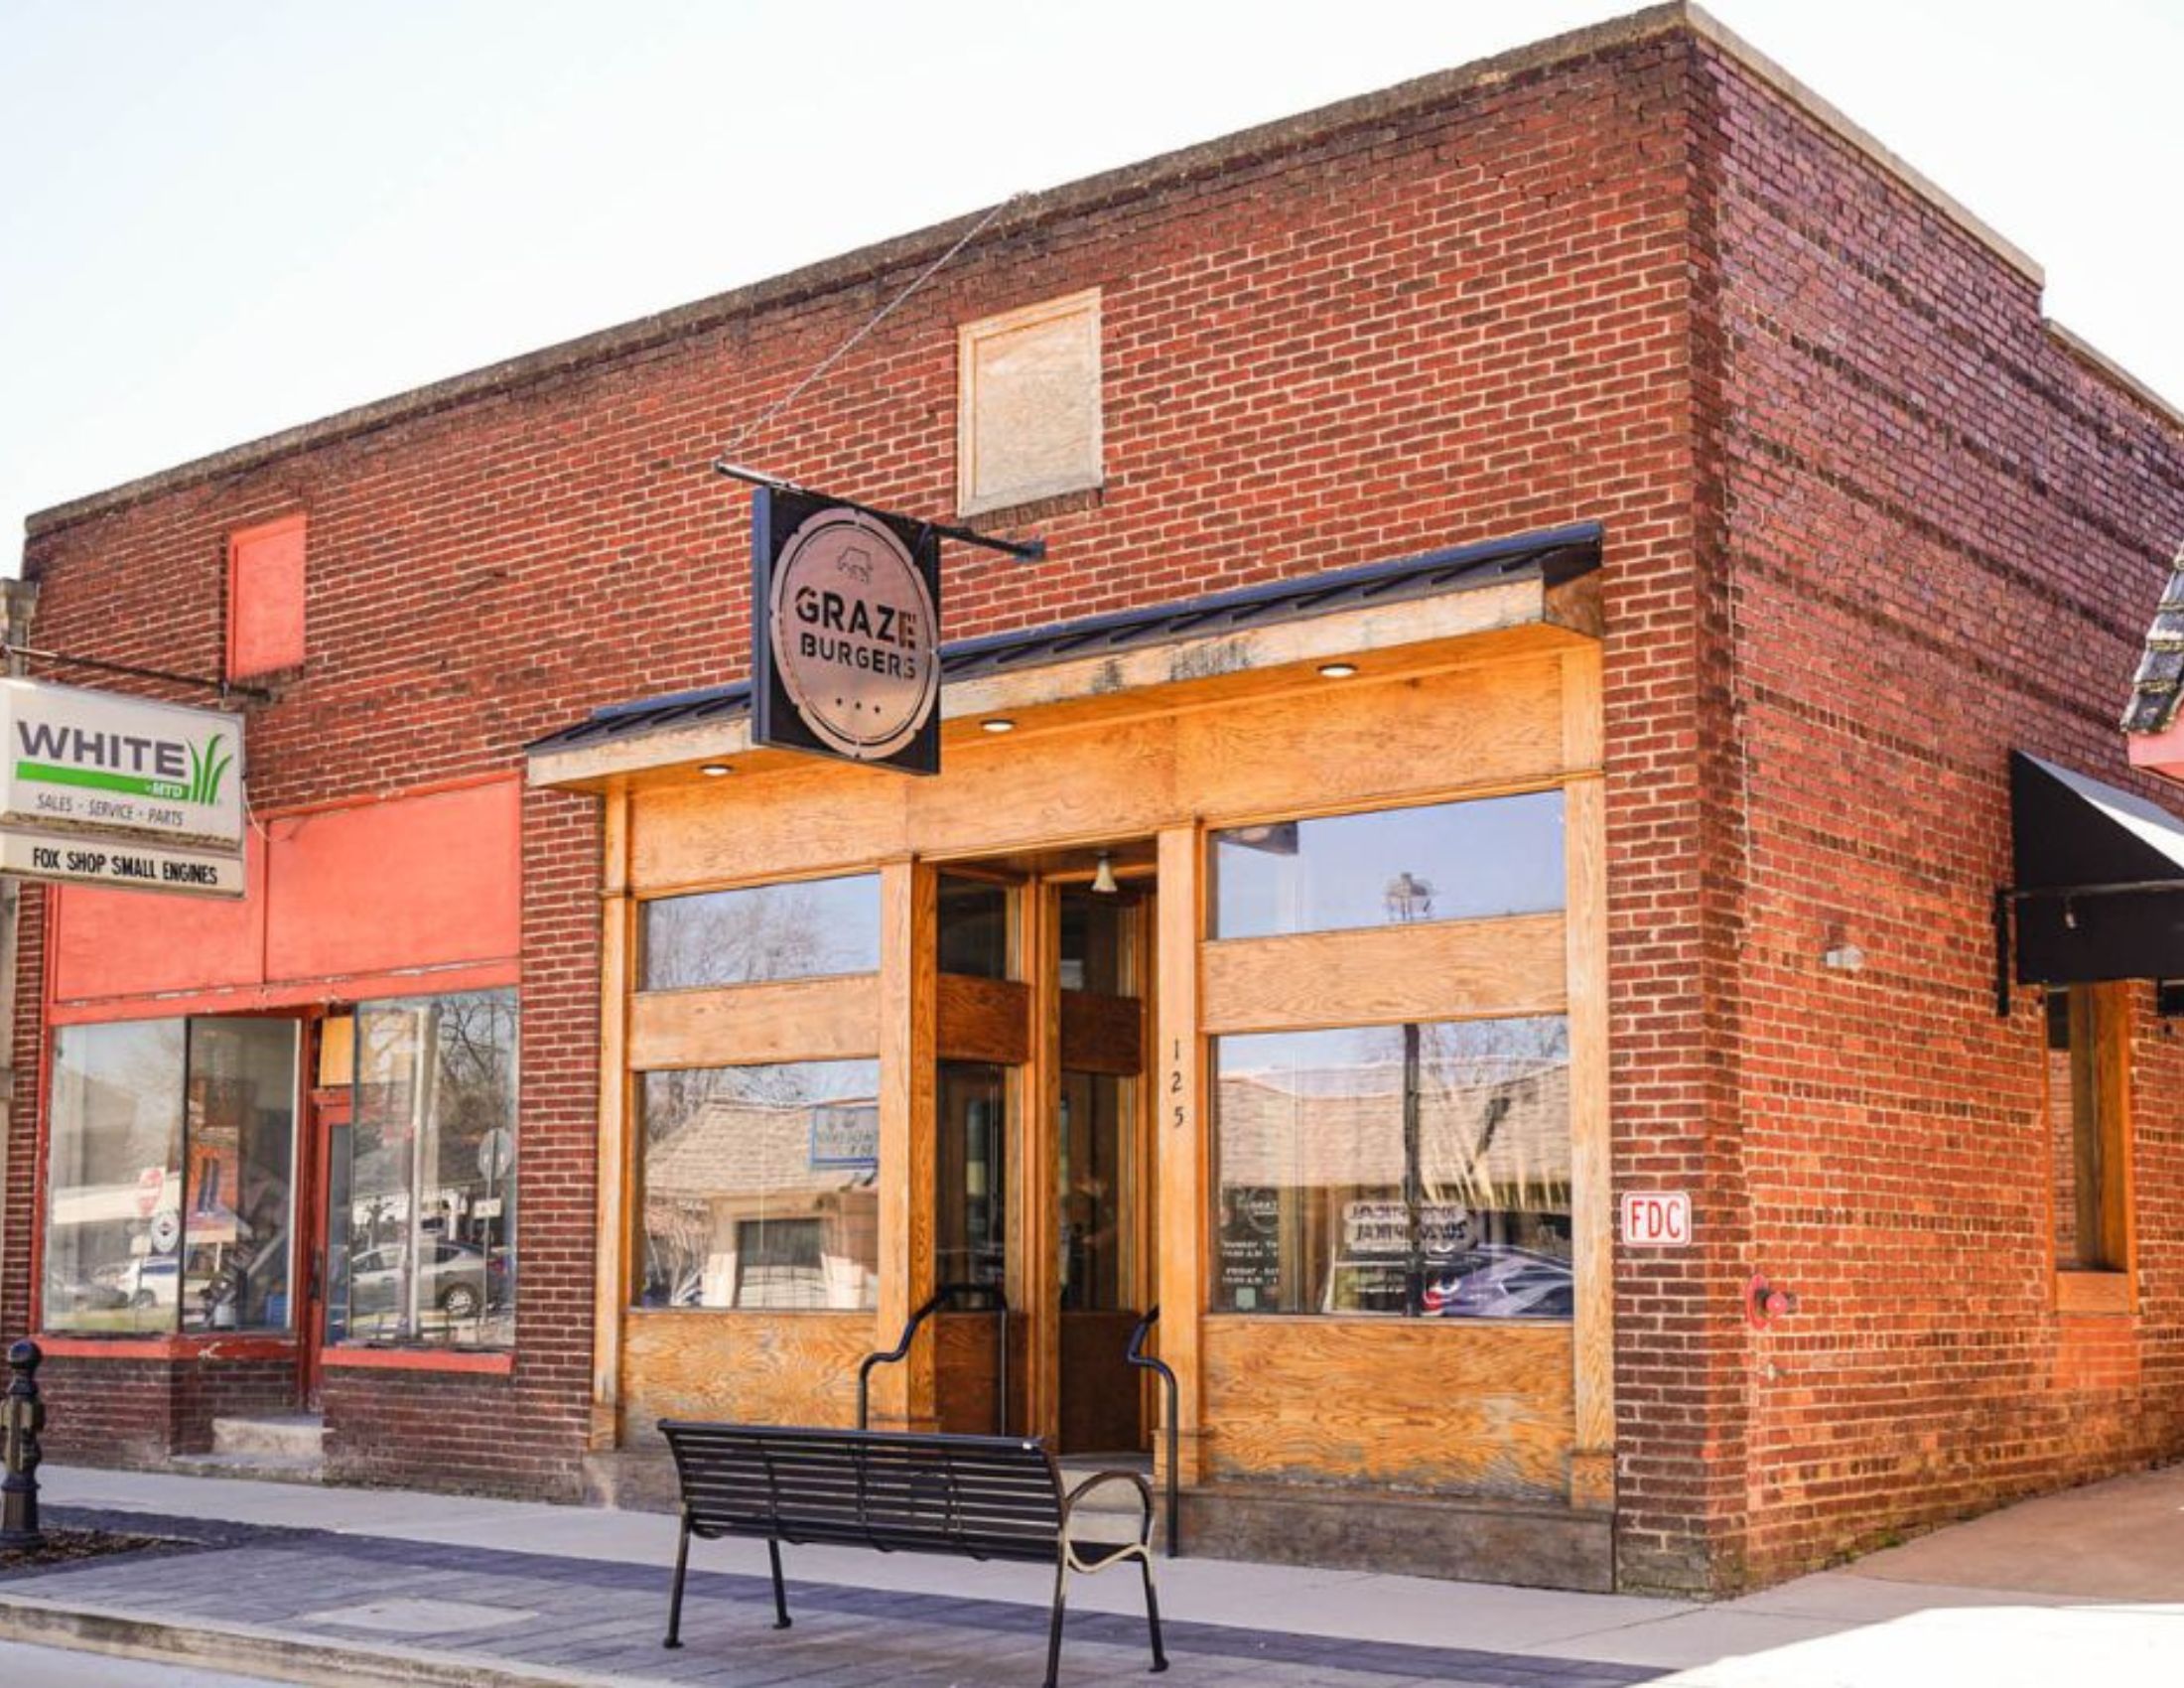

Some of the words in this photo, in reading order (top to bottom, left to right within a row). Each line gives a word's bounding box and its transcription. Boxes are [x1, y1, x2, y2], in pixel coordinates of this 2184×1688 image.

[795, 586, 916, 650] GRAZE
[800, 633, 916, 680] BURGERS
[17, 721, 186, 777] WHITE
[38, 793, 72, 812] SALES
[89, 798, 134, 820] SERVICE
[148, 807, 184, 827] PARTS
[33, 847, 61, 870] FOX
[67, 851, 106, 874] SHOP
[111, 855, 156, 879] SMALL
[163, 860, 218, 885] ENGINES
[1632, 1199, 1680, 1238] FDC
